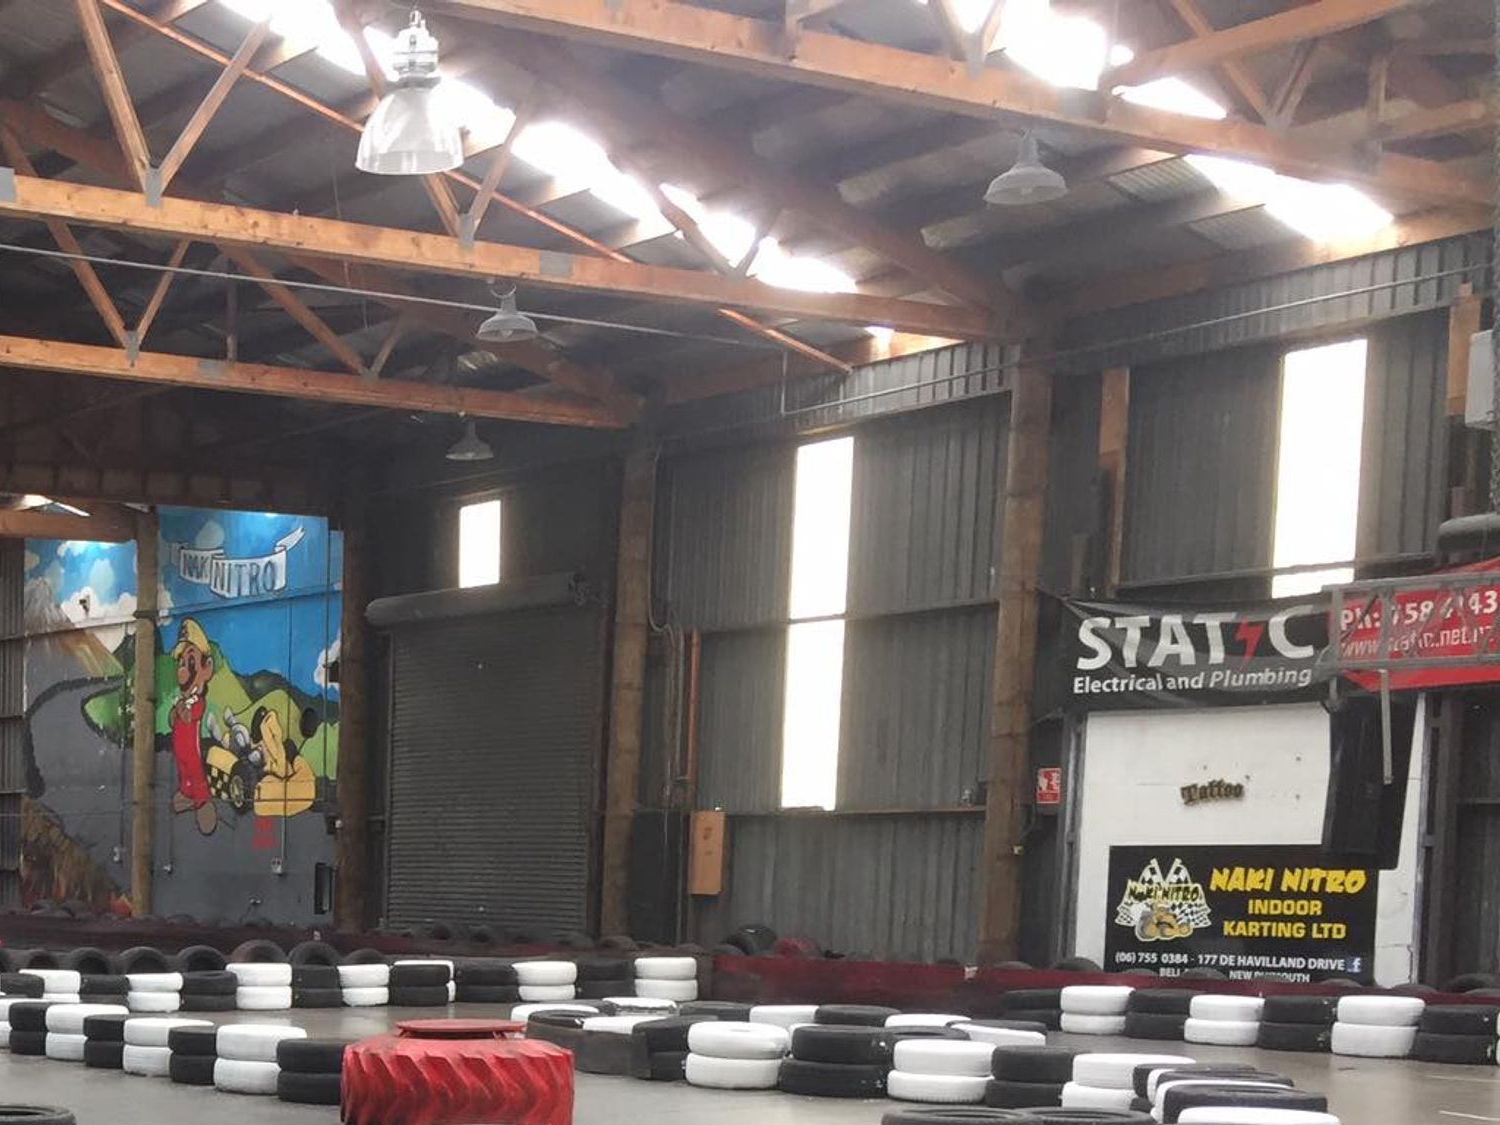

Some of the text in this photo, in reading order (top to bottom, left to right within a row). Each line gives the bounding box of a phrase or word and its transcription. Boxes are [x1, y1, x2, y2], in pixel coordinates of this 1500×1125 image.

[213, 560, 276, 597] NITRO
[1073, 668, 1313, 694] Electrical and Plumbing
[1209, 867, 1367, 894] NAKI NITRO
[1248, 899, 1323, 916] INDOOR
[1223, 920, 1347, 939] KARTING LTD
[1115, 951, 1136, 964] (06)
[1138, 952, 1158, 964] 755
[1161, 953, 1189, 964] 0384
[1198, 954, 1218, 965] 177
[1219, 955, 1235, 966] DE
[1237, 956, 1306, 969] HAVILLAND
[1307, 958, 1345, 971] DRIVE
[1229, 970, 1252, 981] NEW
